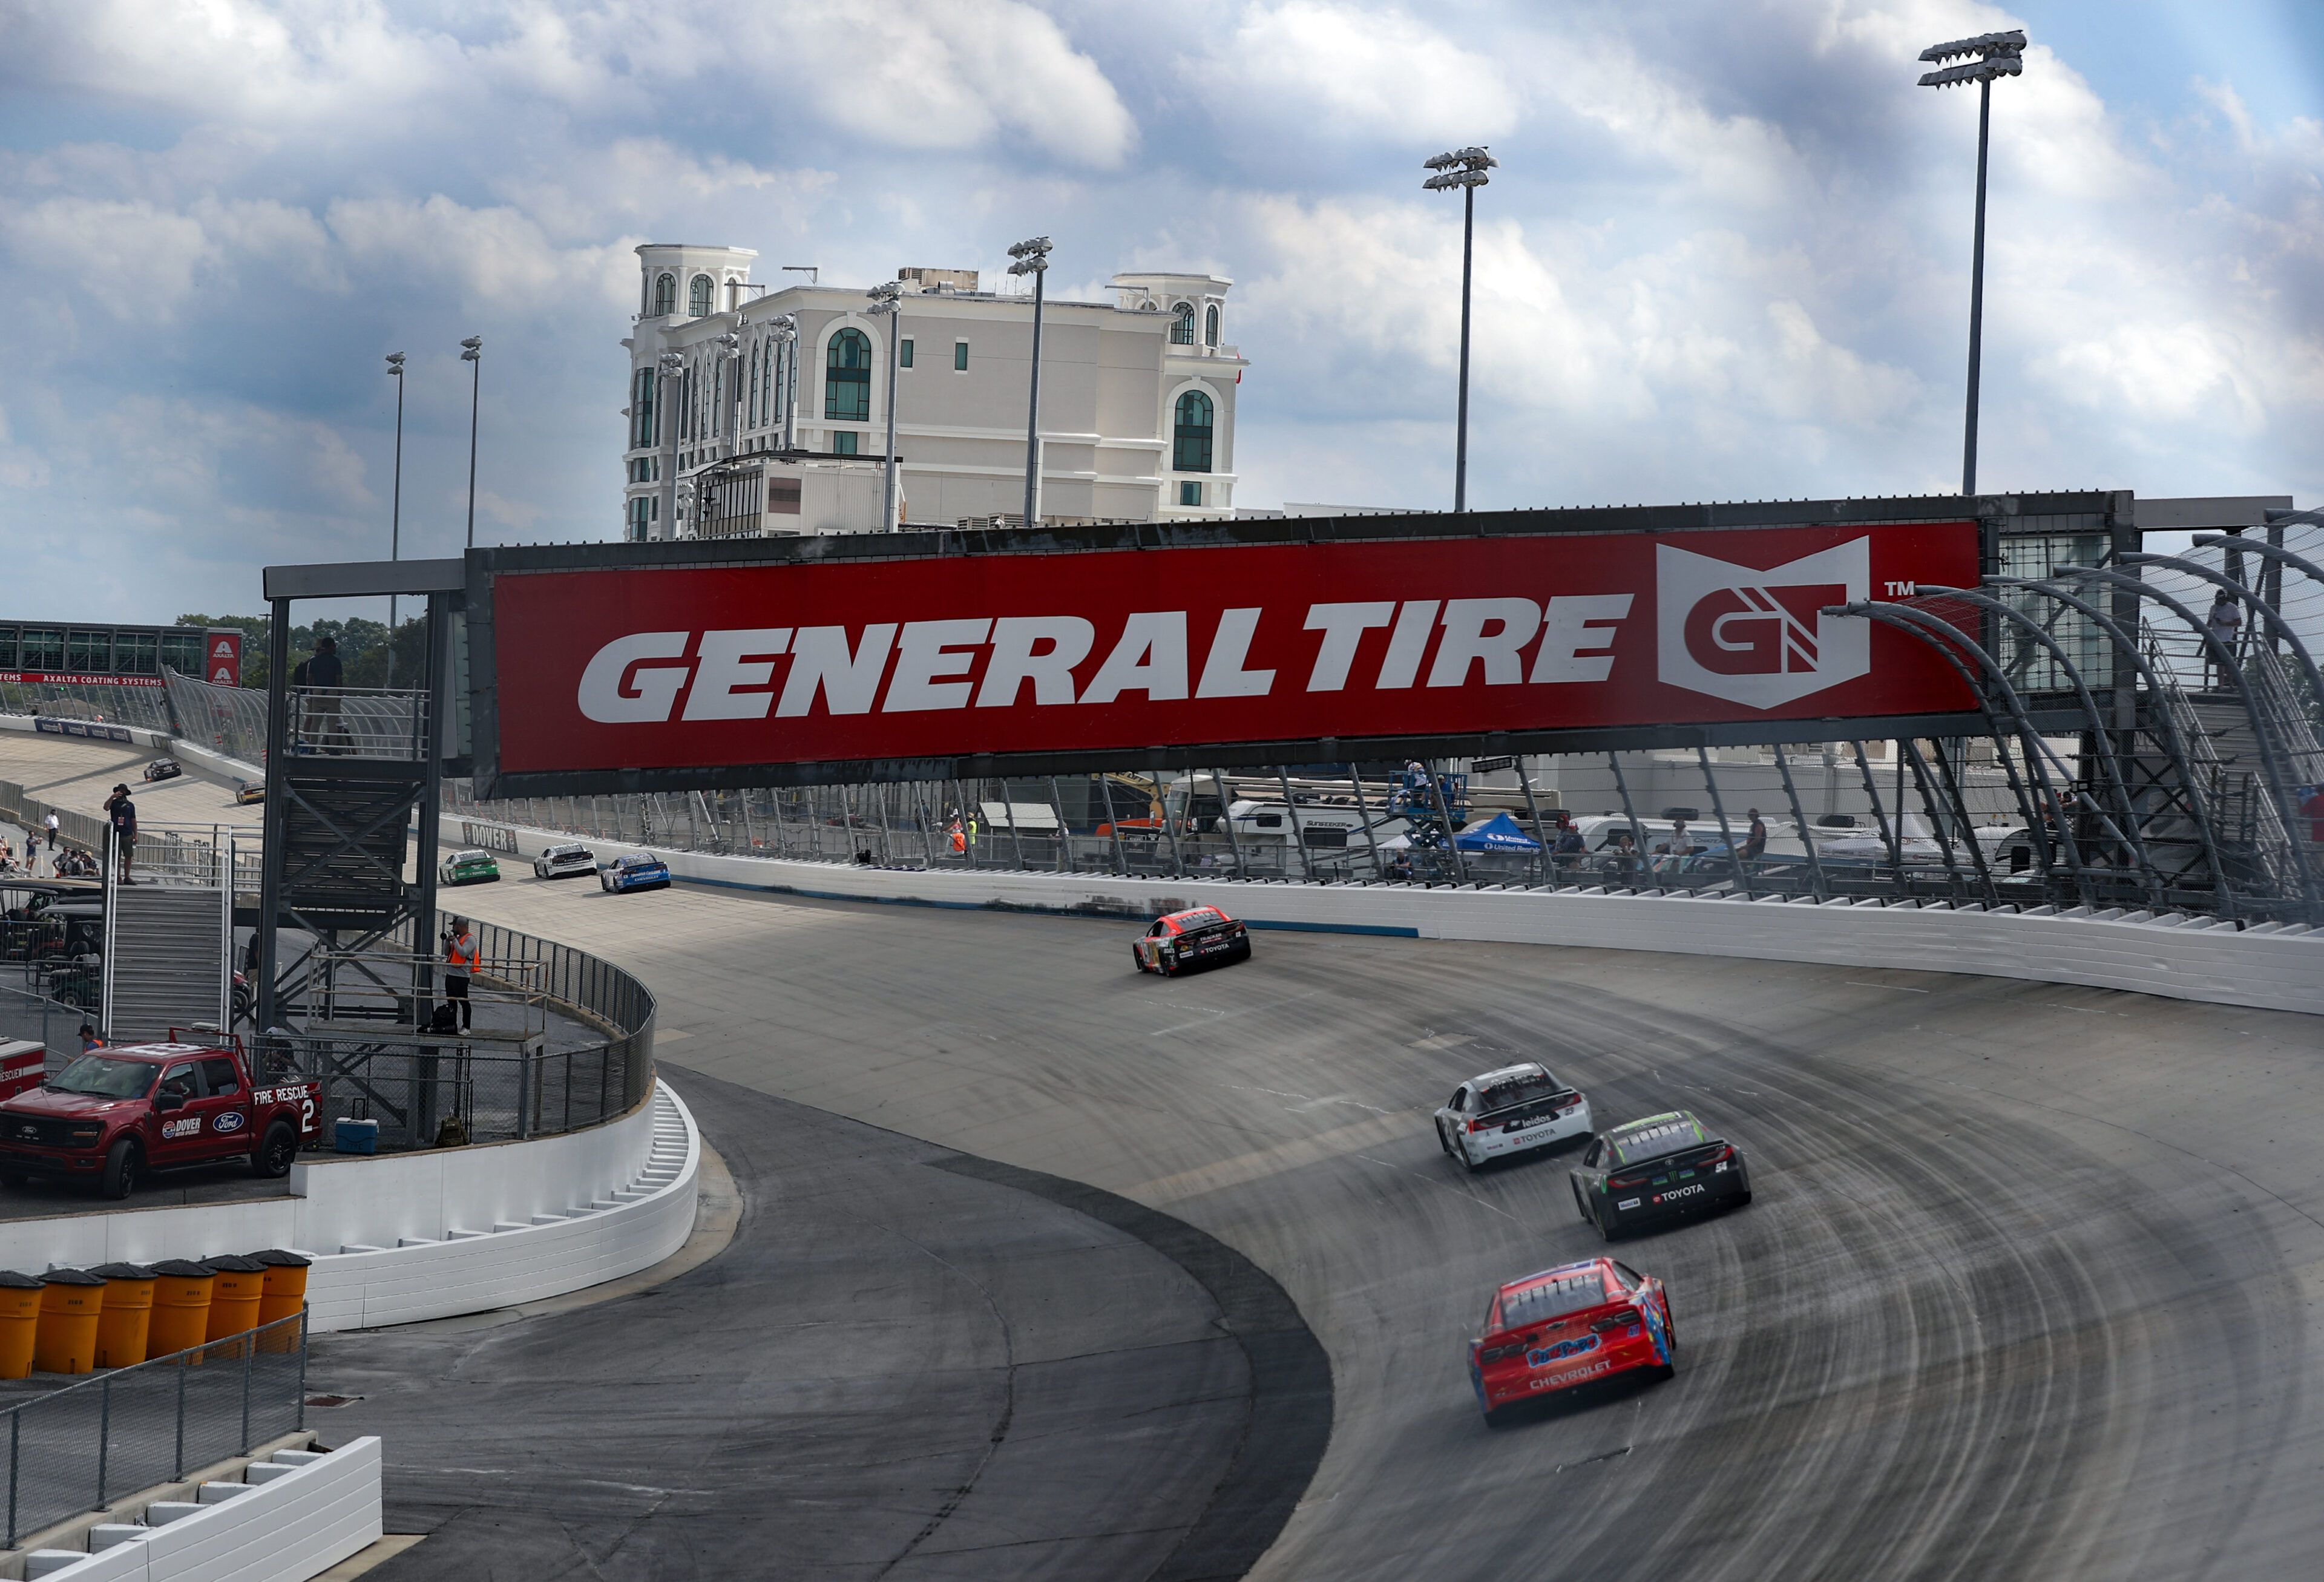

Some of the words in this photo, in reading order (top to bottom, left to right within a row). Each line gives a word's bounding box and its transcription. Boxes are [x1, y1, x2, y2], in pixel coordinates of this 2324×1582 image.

[1884, 581, 1914, 596] TM
[578, 607, 1277, 723] GENERAL
[1302, 593, 1635, 692] TIRE
[44, 675, 77, 683] AXALTA
[80, 676, 119, 684] COATING
[122, 677, 162, 686] SYSTEMS
[472, 824, 508, 850] DOVER
[1200, 933, 1222, 942] TRACKER
[1205, 943, 1230, 953] TOYOTA
[254, 1090, 274, 1105] FIRE
[276, 1085, 309, 1101] RESCUE
[218, 1115, 238, 1129] Ford
[302, 1099, 314, 1132] 2
[1522, 1114, 1551, 1127] leidos
[176, 1117, 201, 1131] DOVER
[1521, 1129, 1557, 1143] TOYOTA
[1715, 1161, 1727, 1173] 54
[1661, 1183, 1705, 1201] TOYOTA
[1530, 1360, 1611, 1390] CHEVROLET
